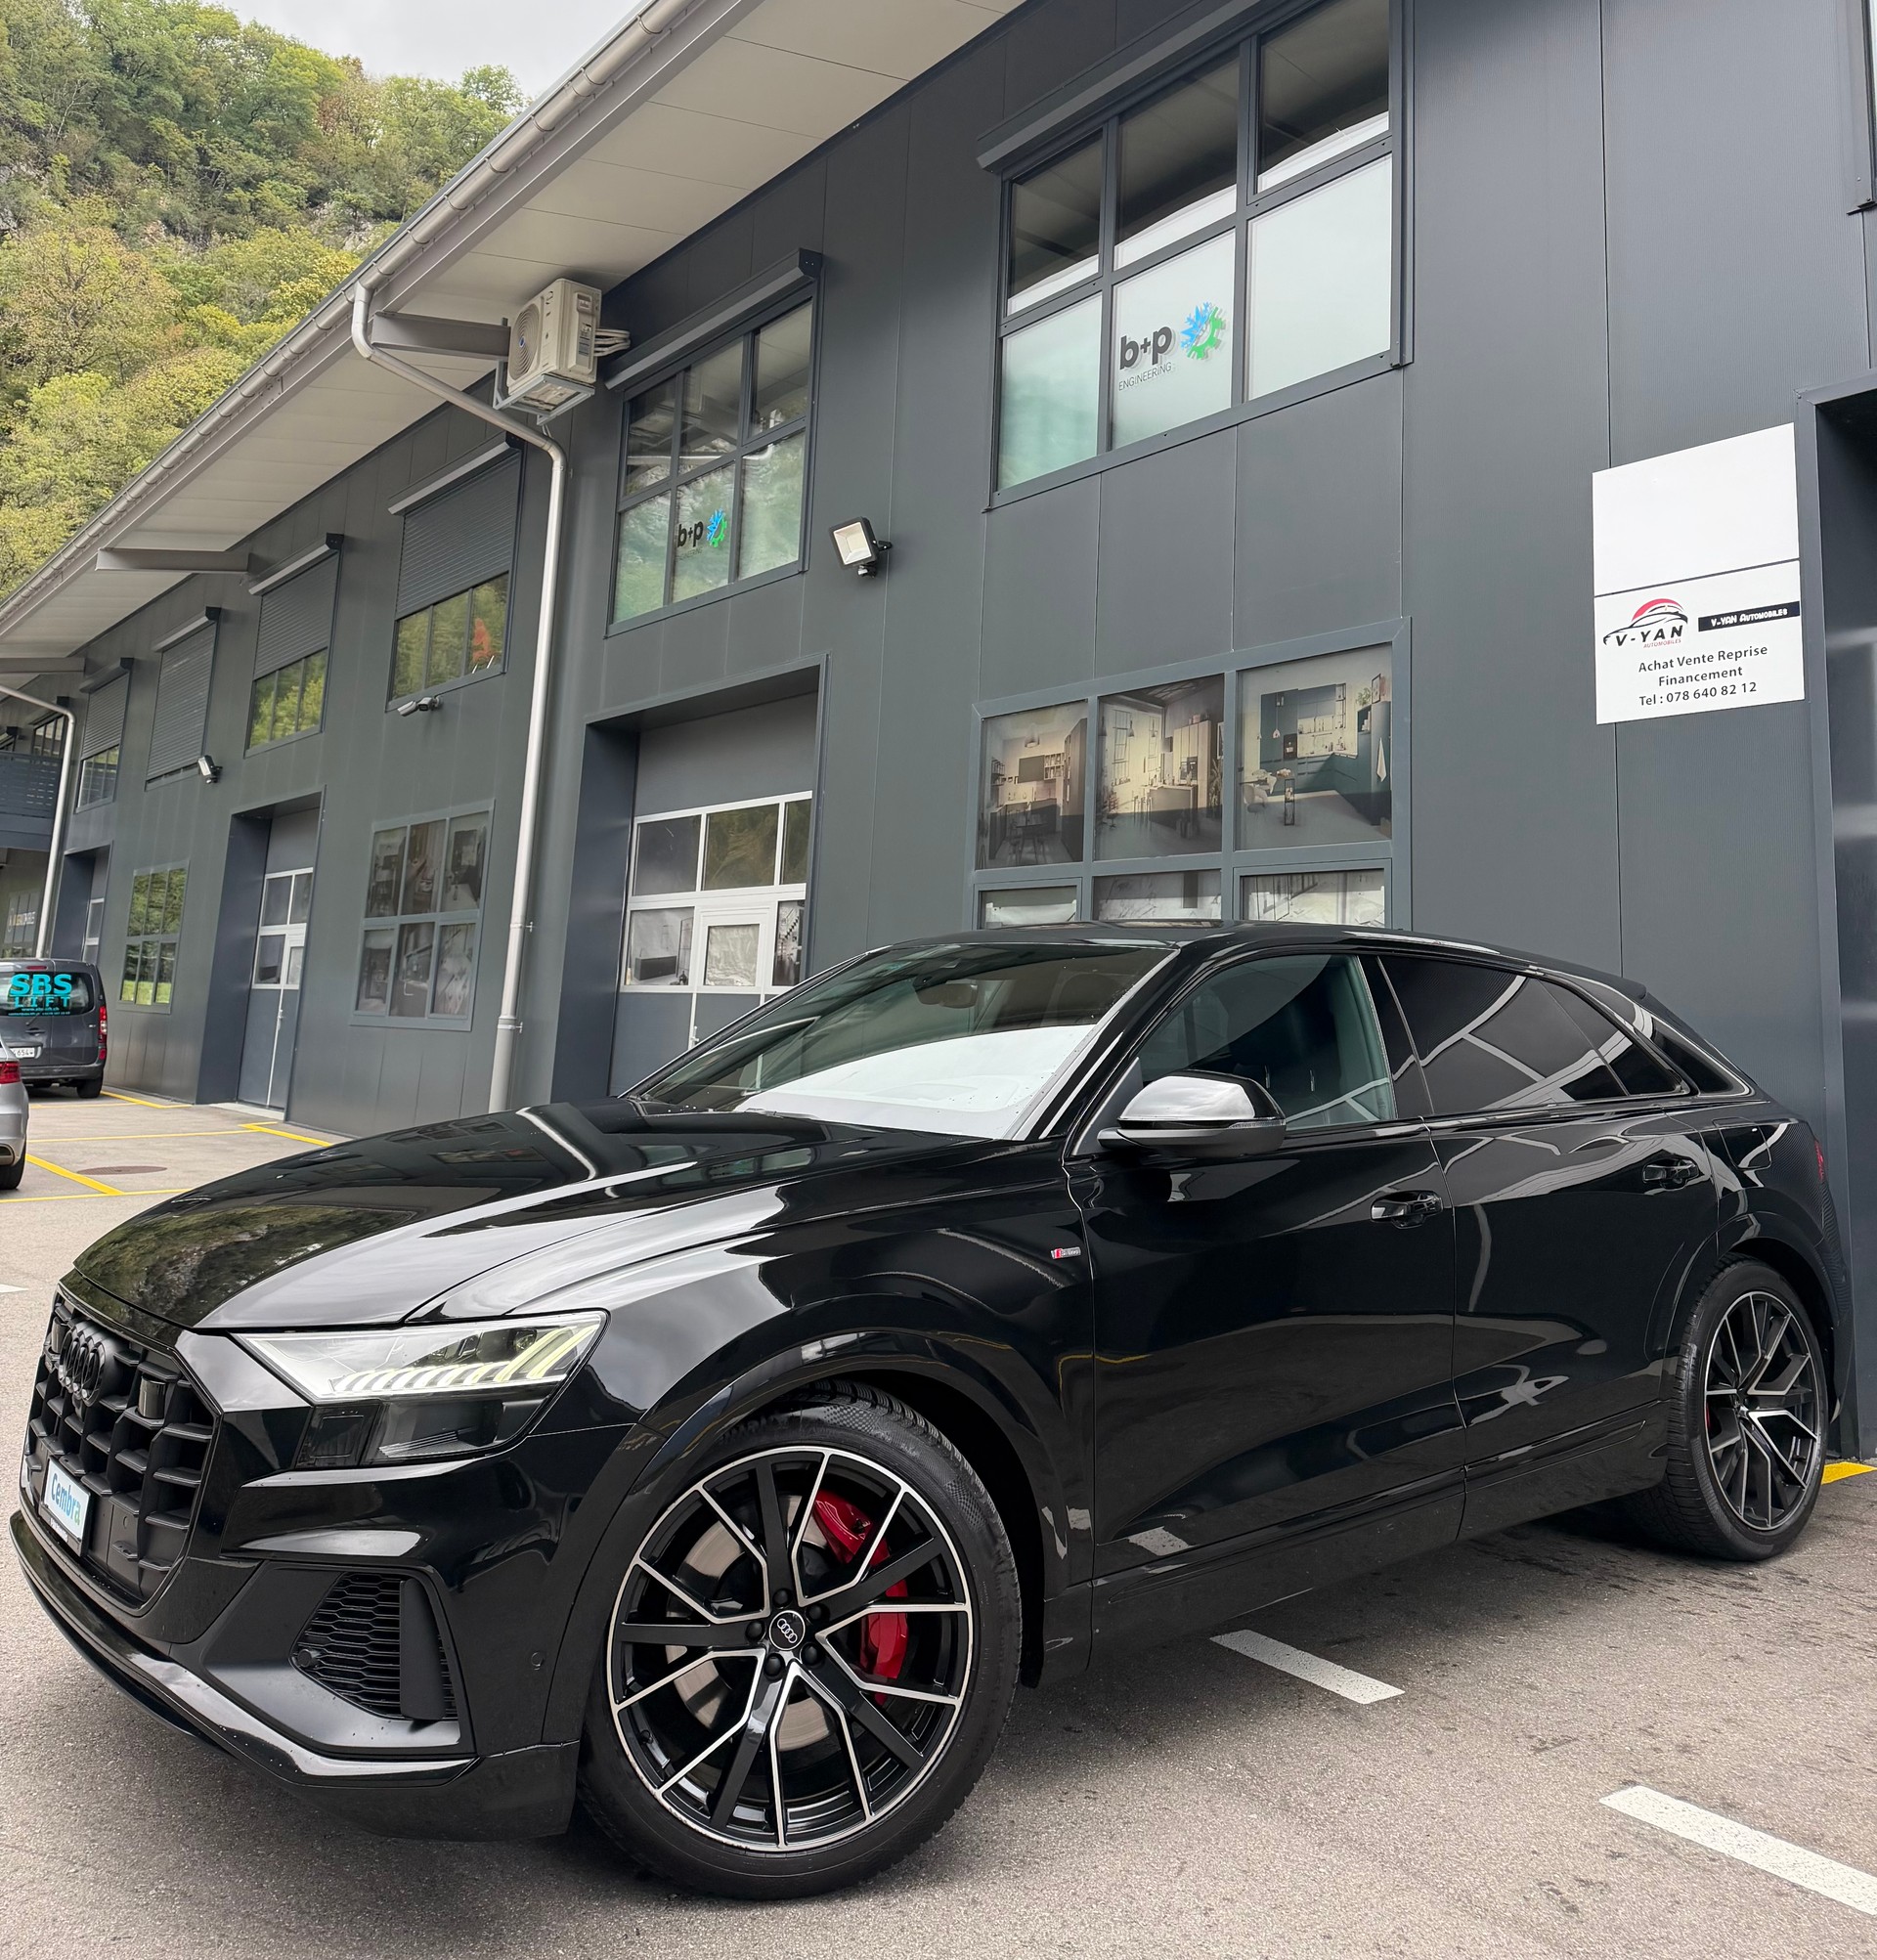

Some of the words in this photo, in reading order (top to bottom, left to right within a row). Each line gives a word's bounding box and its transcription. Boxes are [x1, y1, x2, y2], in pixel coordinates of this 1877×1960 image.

[1119, 326, 1173, 370] b+p
[1118, 361, 1173, 392] ENGINEERING
[677, 520, 704, 547] b+p
[1711, 614, 1738, 628] V-YAN
[1615, 625, 1683, 647] V-YAN
[1642, 638, 1681, 649] AUTOMOBILES
[1638, 659, 1675, 673] Achat
[1677, 654, 1715, 667] Vente
[1718, 645, 1768, 662] Reprise
[1658, 666, 1743, 687] Financement
[1638, 694, 1657, 706] Tel
[1666, 690, 1690, 703] 078
[1693, 686, 1718, 699] 640
[1721, 684, 1737, 696] 82
[1741, 681, 1758, 693] 12
[10, 974, 72, 995] SBS
[15, 996, 71, 1007] LIFT
[51, 1472, 81, 1526] Cembra
